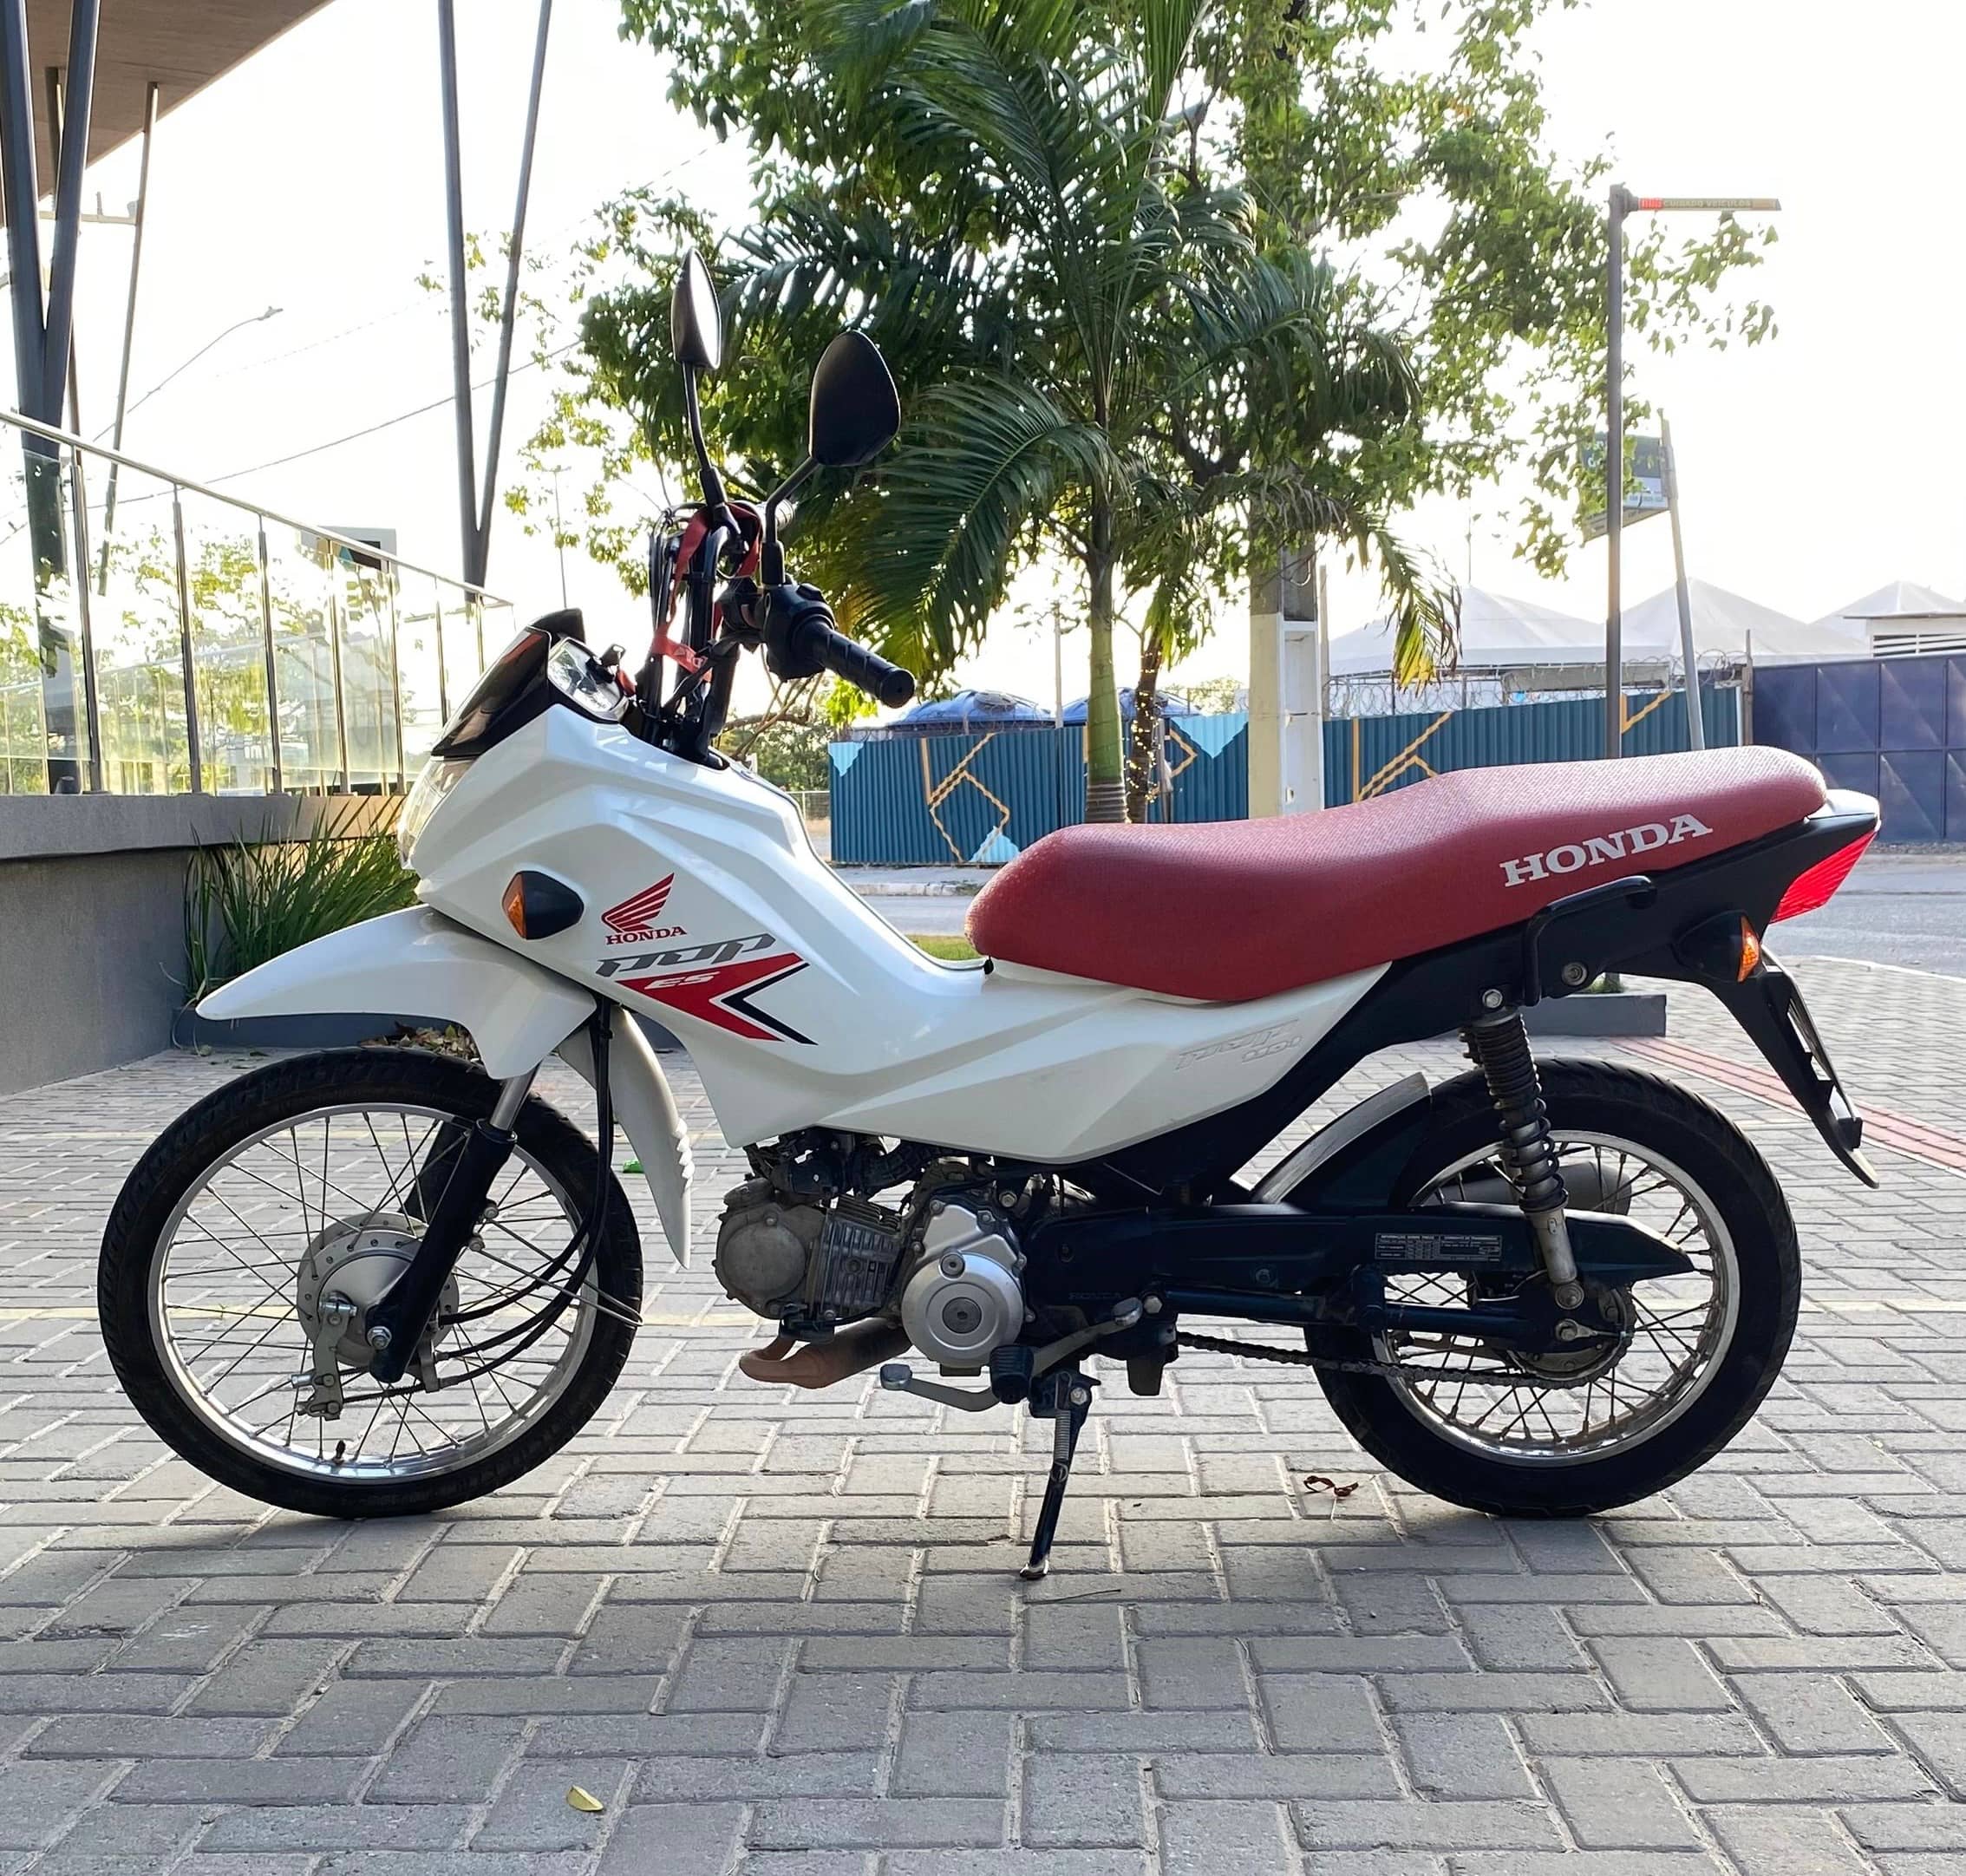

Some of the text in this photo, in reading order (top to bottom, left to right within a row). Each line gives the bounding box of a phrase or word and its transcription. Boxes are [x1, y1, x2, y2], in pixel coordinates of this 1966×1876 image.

[1499, 814, 1714, 887] HONDA
[605, 925, 688, 945] HONDA
[644, 971, 721, 990] ES
